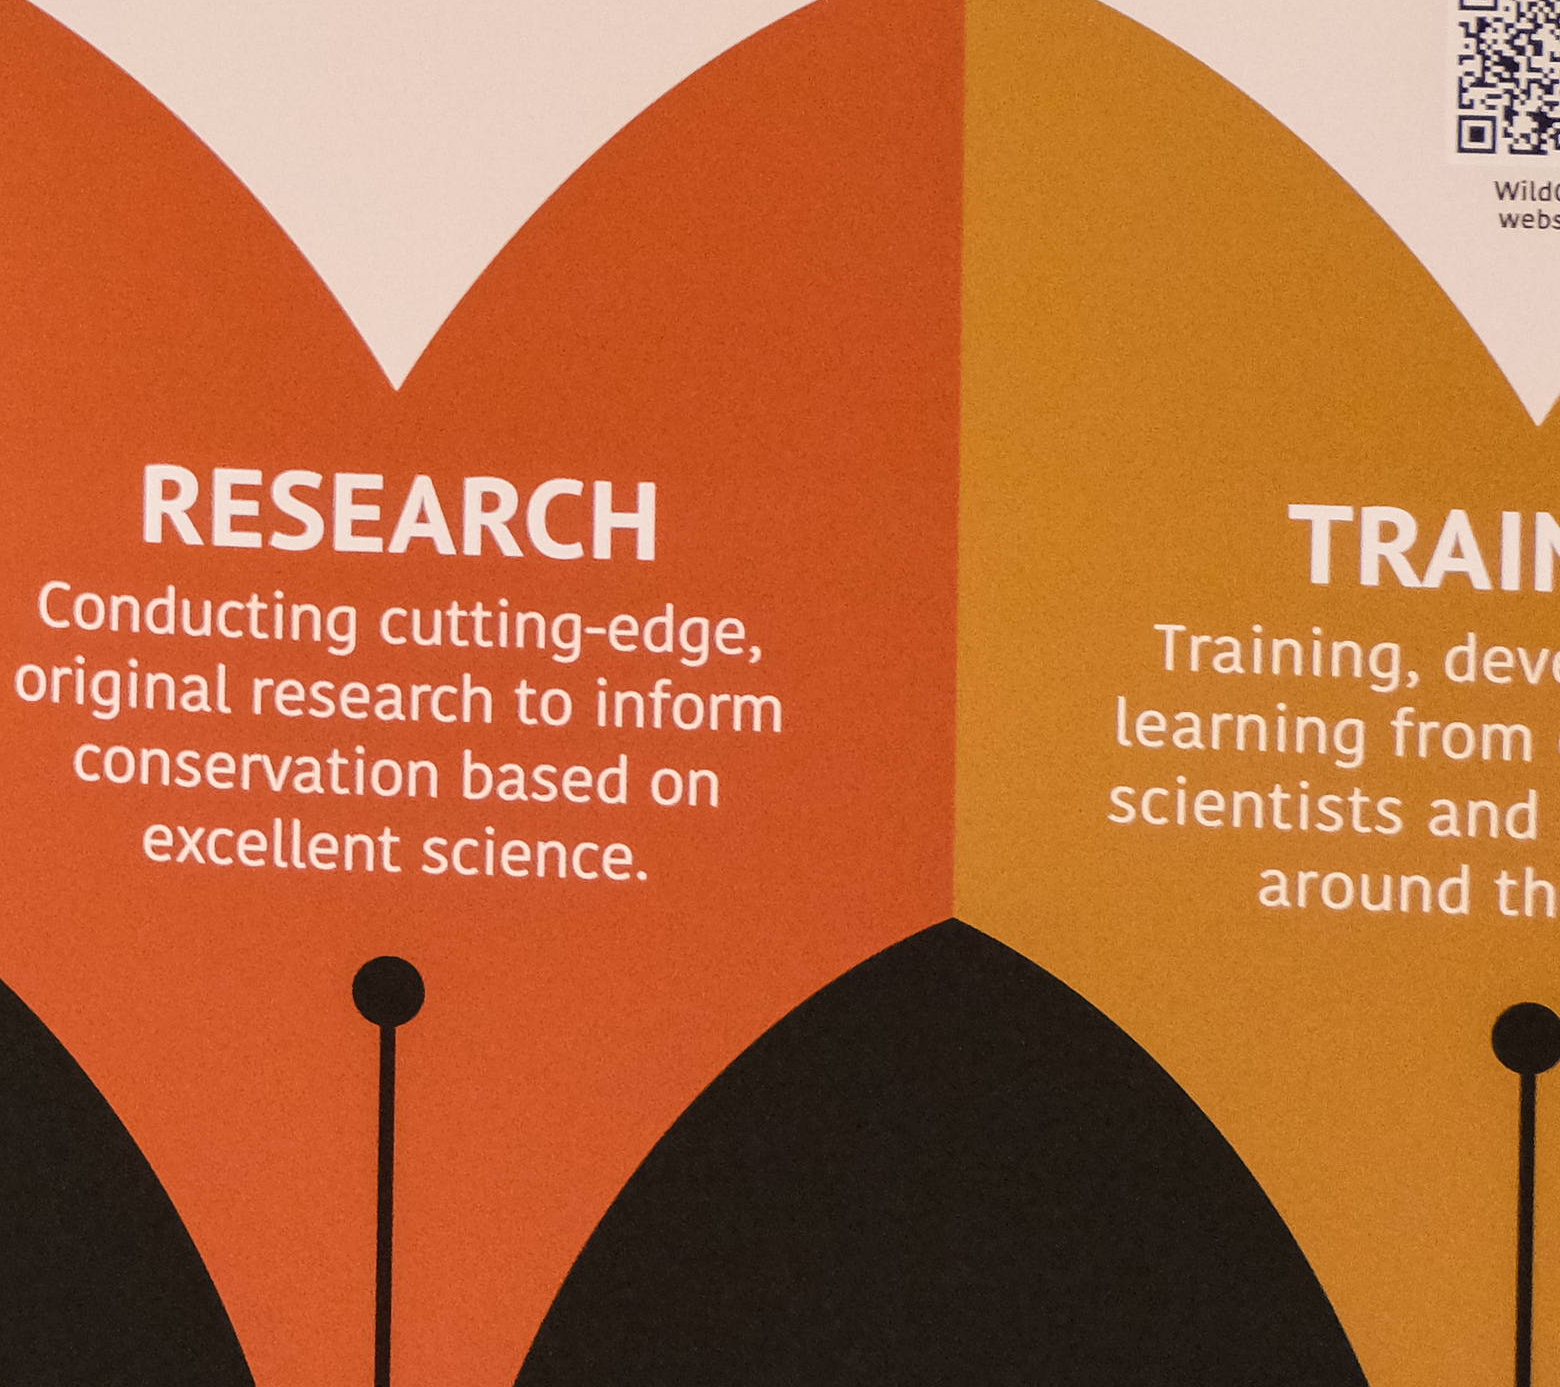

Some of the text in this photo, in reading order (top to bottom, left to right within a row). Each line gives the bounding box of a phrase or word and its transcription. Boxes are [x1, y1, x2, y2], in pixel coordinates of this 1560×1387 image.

[143, 464, 656, 560] RESEARCH
[38, 581, 761, 667] Conducting cutting-edge,
[1154, 624, 1419, 693] Training,
[15, 655, 781, 732] original research to inform
[1117, 696, 1532, 769] learning from
[74, 744, 718, 807] conservation based on
[1108, 776, 1537, 840] scientists and
[143, 818, 647, 880] excellent science.
[1259, 864, 1470, 914] around
